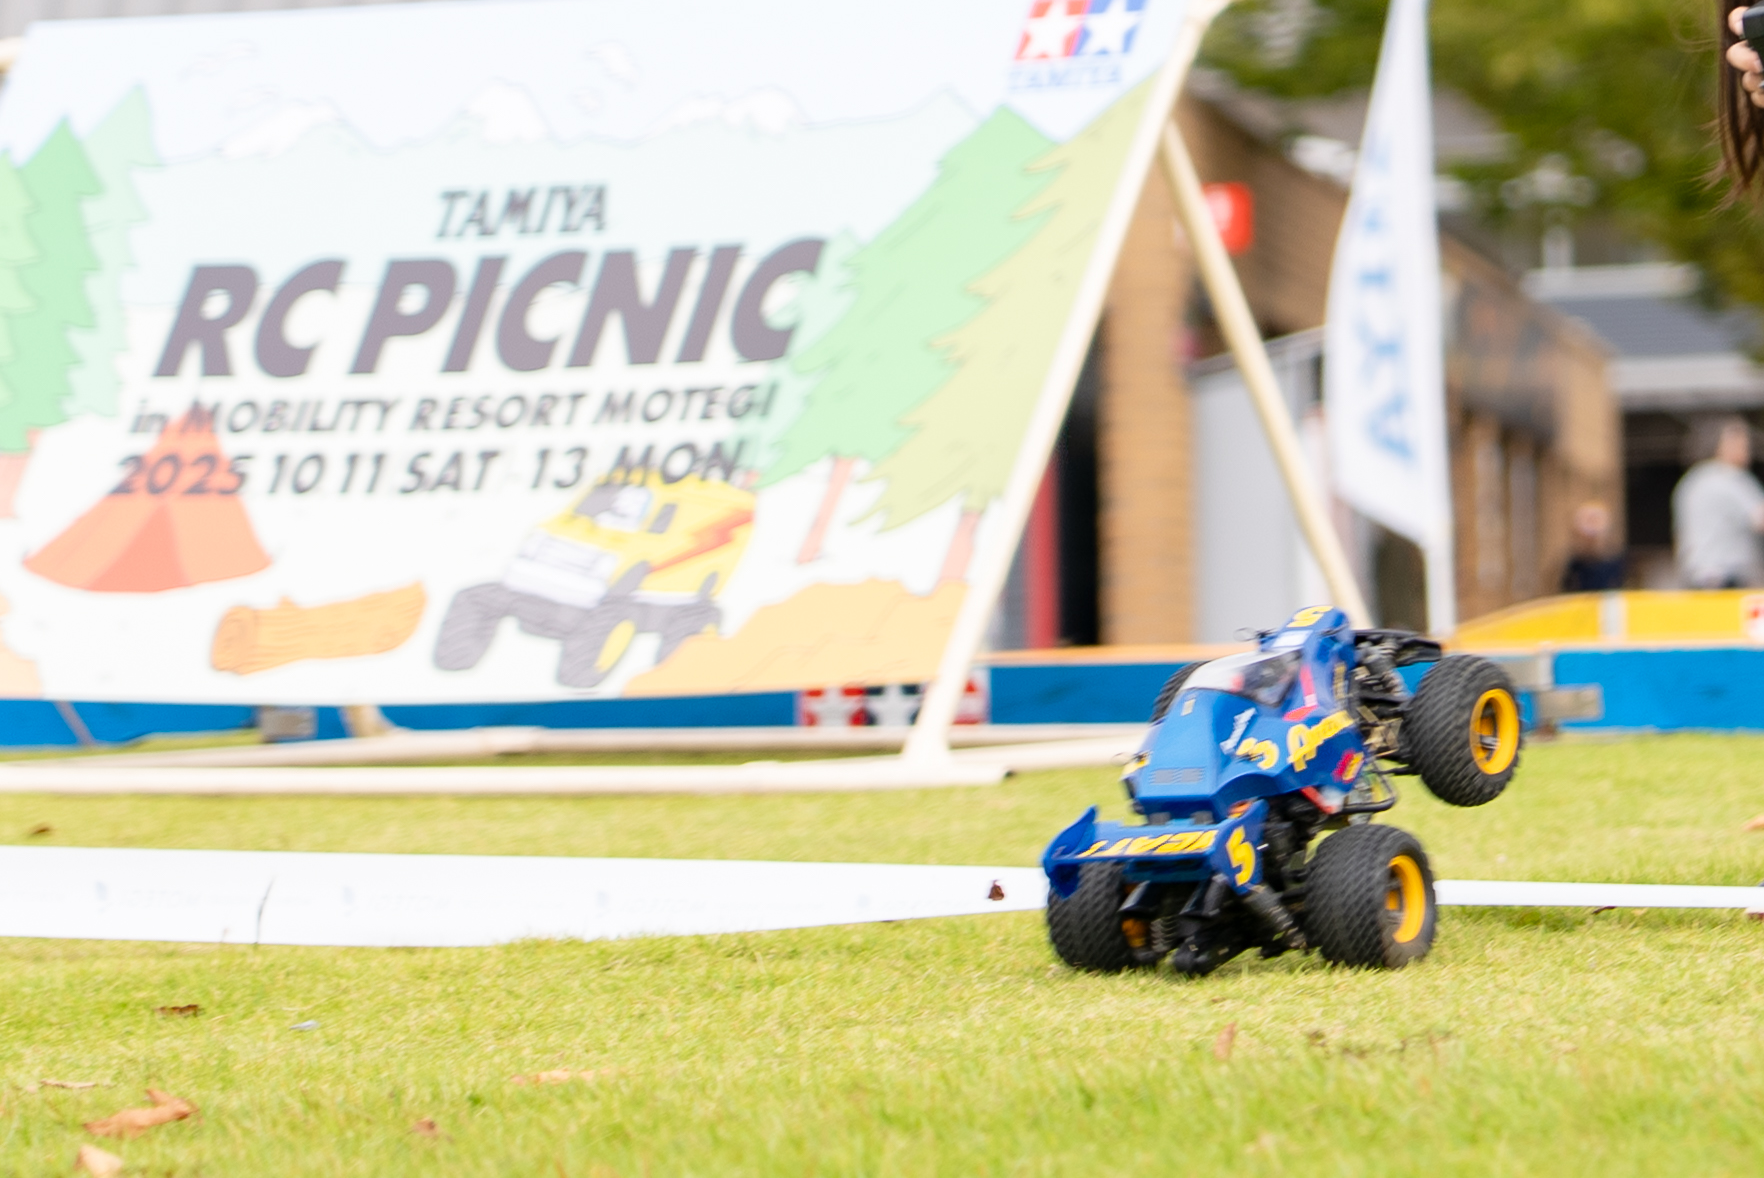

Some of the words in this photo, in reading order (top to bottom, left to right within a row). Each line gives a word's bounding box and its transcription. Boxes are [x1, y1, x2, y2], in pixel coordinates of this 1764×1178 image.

[435, 184, 608, 239] TAMIYA
[152, 258, 347, 379] RC
[349, 238, 827, 374] PICNIC
[128, 398, 170, 434] in
[179, 395, 401, 434] MOBILITY
[407, 389, 589, 431] RESORT
[591, 380, 781, 425] MOTEGI
[106, 450, 256, 496] 2025
[267, 451, 327, 496] 10
[338, 450, 388, 496] 11
[399, 447, 504, 495] SAT
[529, 444, 592, 490] 13
[605, 435, 756, 486] MON
